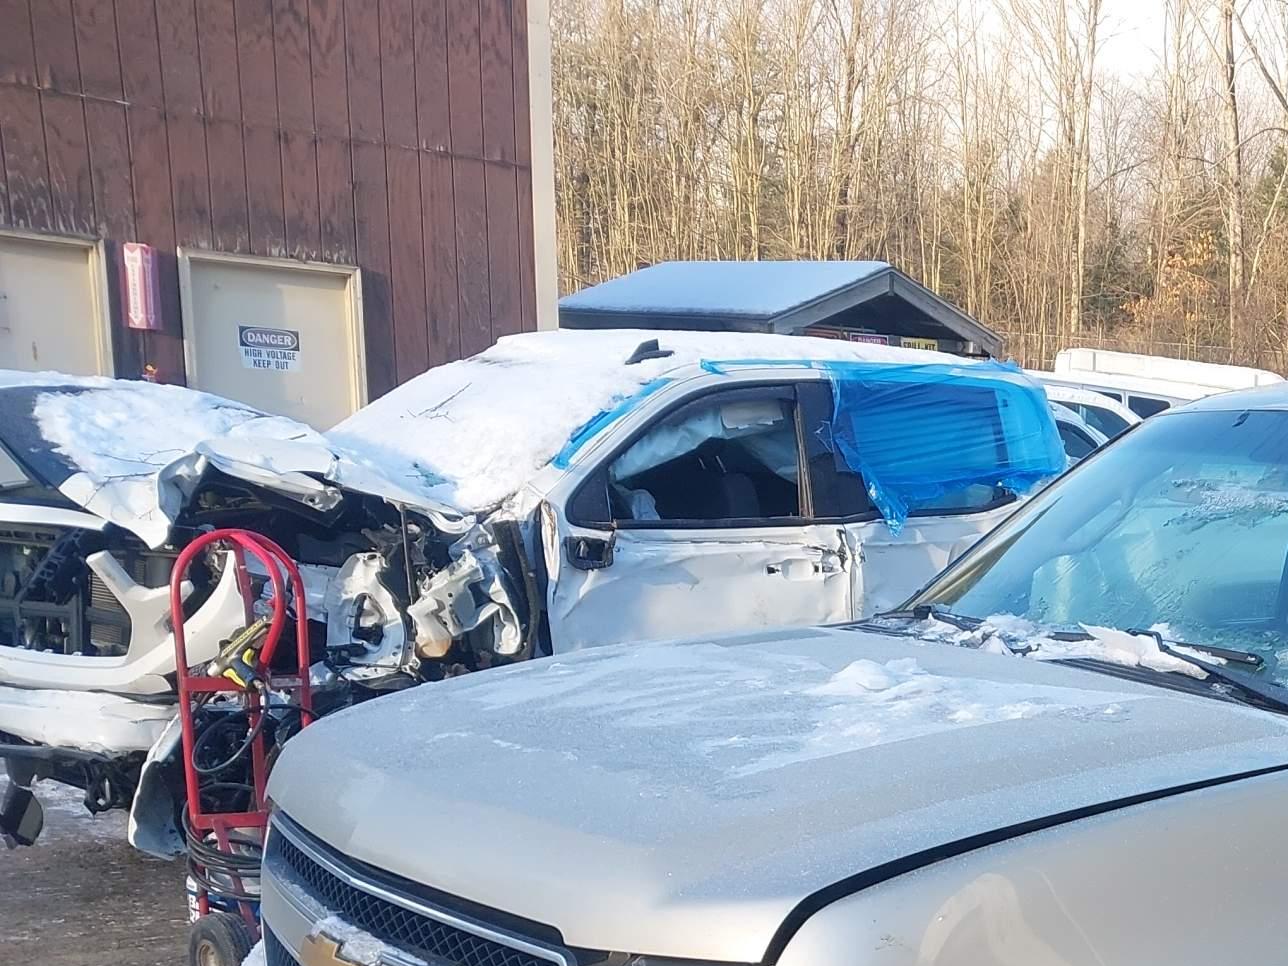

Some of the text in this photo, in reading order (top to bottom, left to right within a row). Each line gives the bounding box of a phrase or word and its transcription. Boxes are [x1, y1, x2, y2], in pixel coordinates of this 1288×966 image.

[247, 332, 292, 346] DANGER
[244, 348, 297, 361] HIGH VOLTAGE
[253, 359, 289, 370] KEEP OUT
